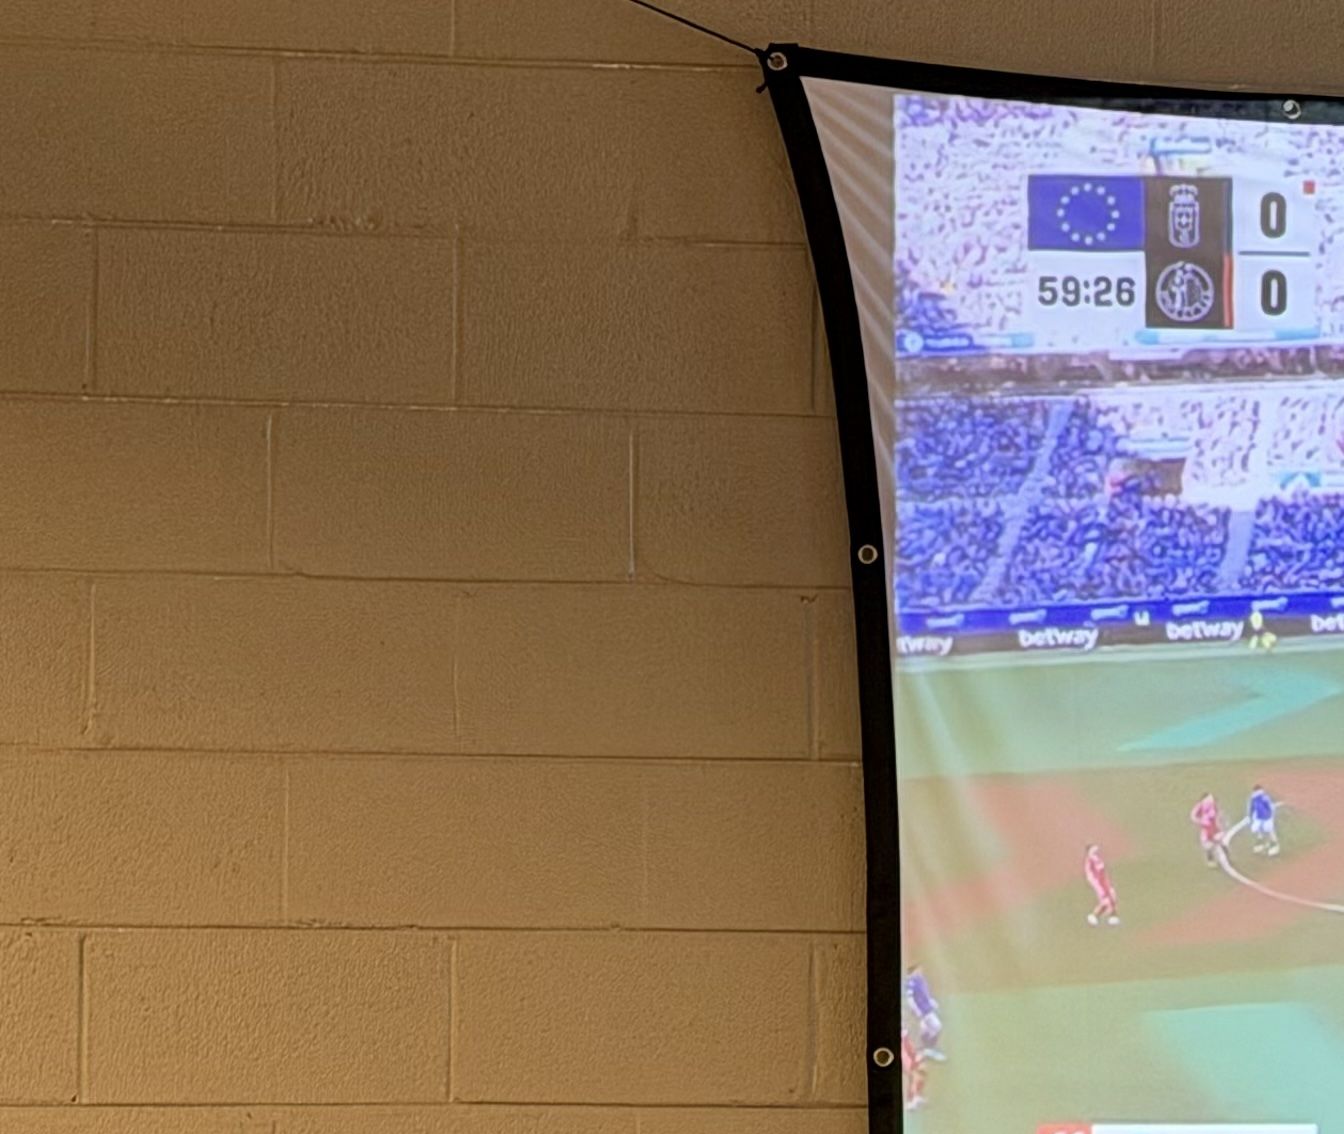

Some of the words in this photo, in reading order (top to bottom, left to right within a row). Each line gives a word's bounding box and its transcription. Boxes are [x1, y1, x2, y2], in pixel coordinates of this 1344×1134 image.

[1260, 191, 1287, 239] 0
[1037, 275, 1136, 307] 59:26
[1261, 269, 1287, 316] 0
[1018, 627, 1098, 650] betway
[1166, 618, 1244, 641] betway
